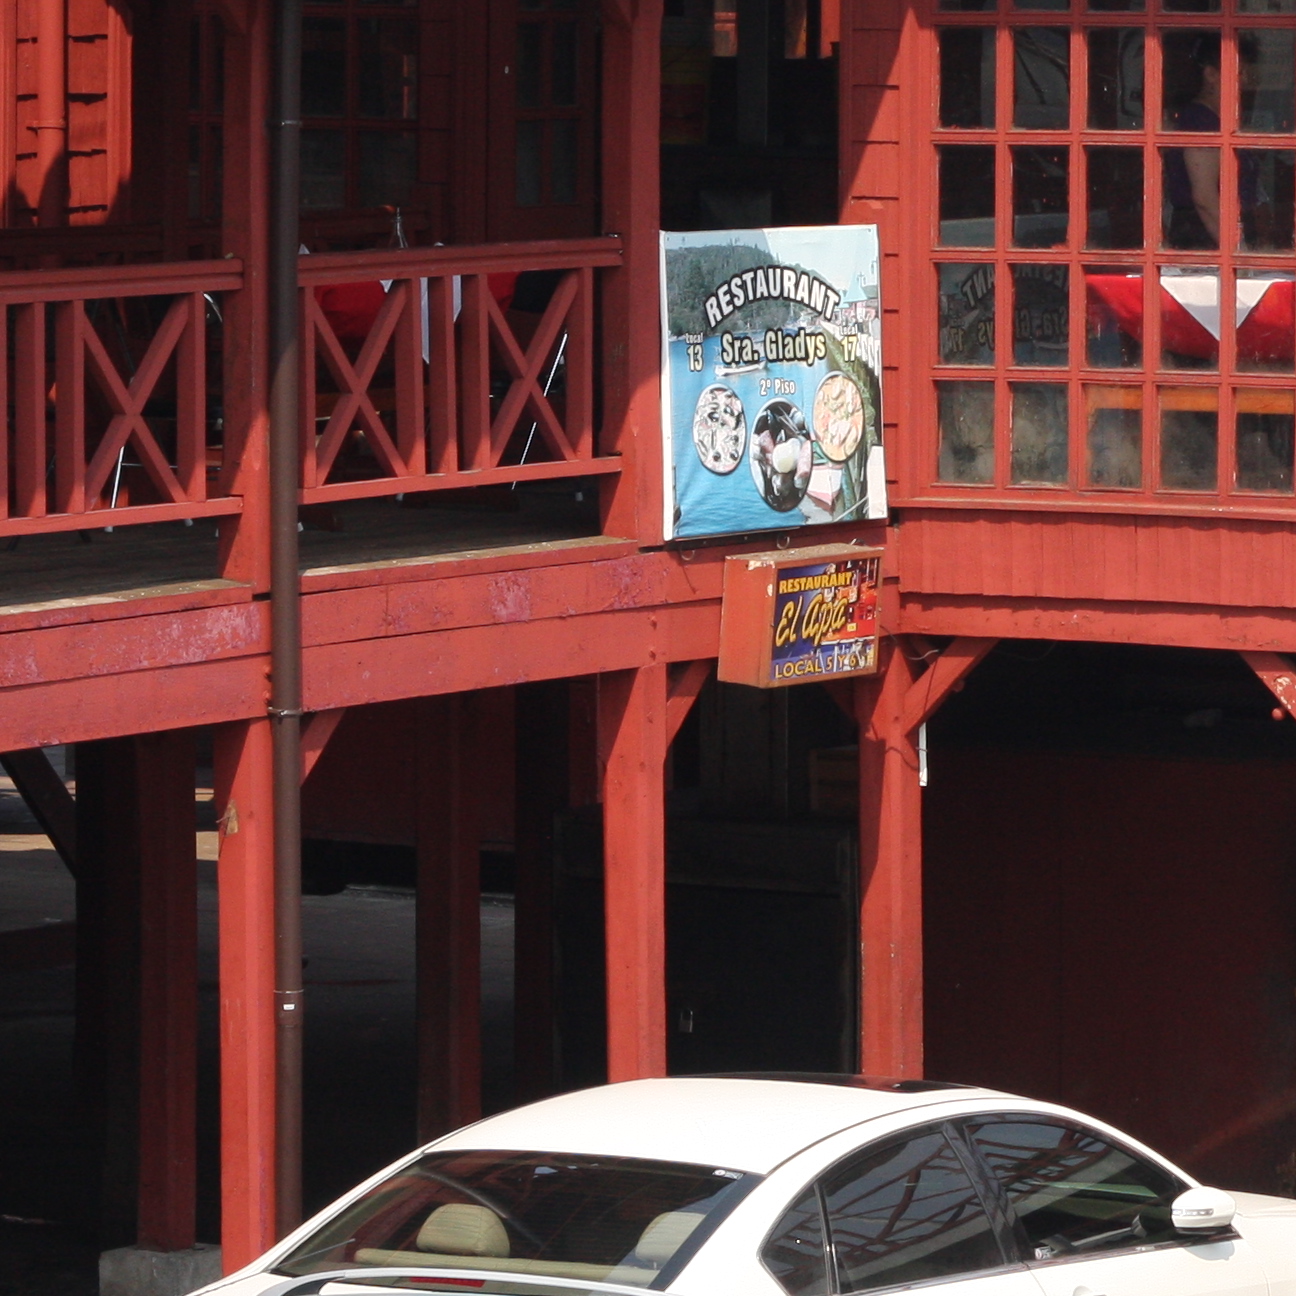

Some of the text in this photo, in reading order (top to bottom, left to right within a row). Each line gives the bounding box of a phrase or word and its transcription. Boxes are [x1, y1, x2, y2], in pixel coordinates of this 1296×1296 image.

[704, 266, 840, 328] RESTAURANT
[687, 344, 704, 372] 13
[721, 328, 827, 366] Sra. Gladys
[841, 336, 858, 363] 17
[774, 378, 796, 395] Piso
[779, 571, 854, 594] RESTAURANT
[776, 595, 803, 647] El
[775, 653, 857, 679] LOCAL 5 Y 6
